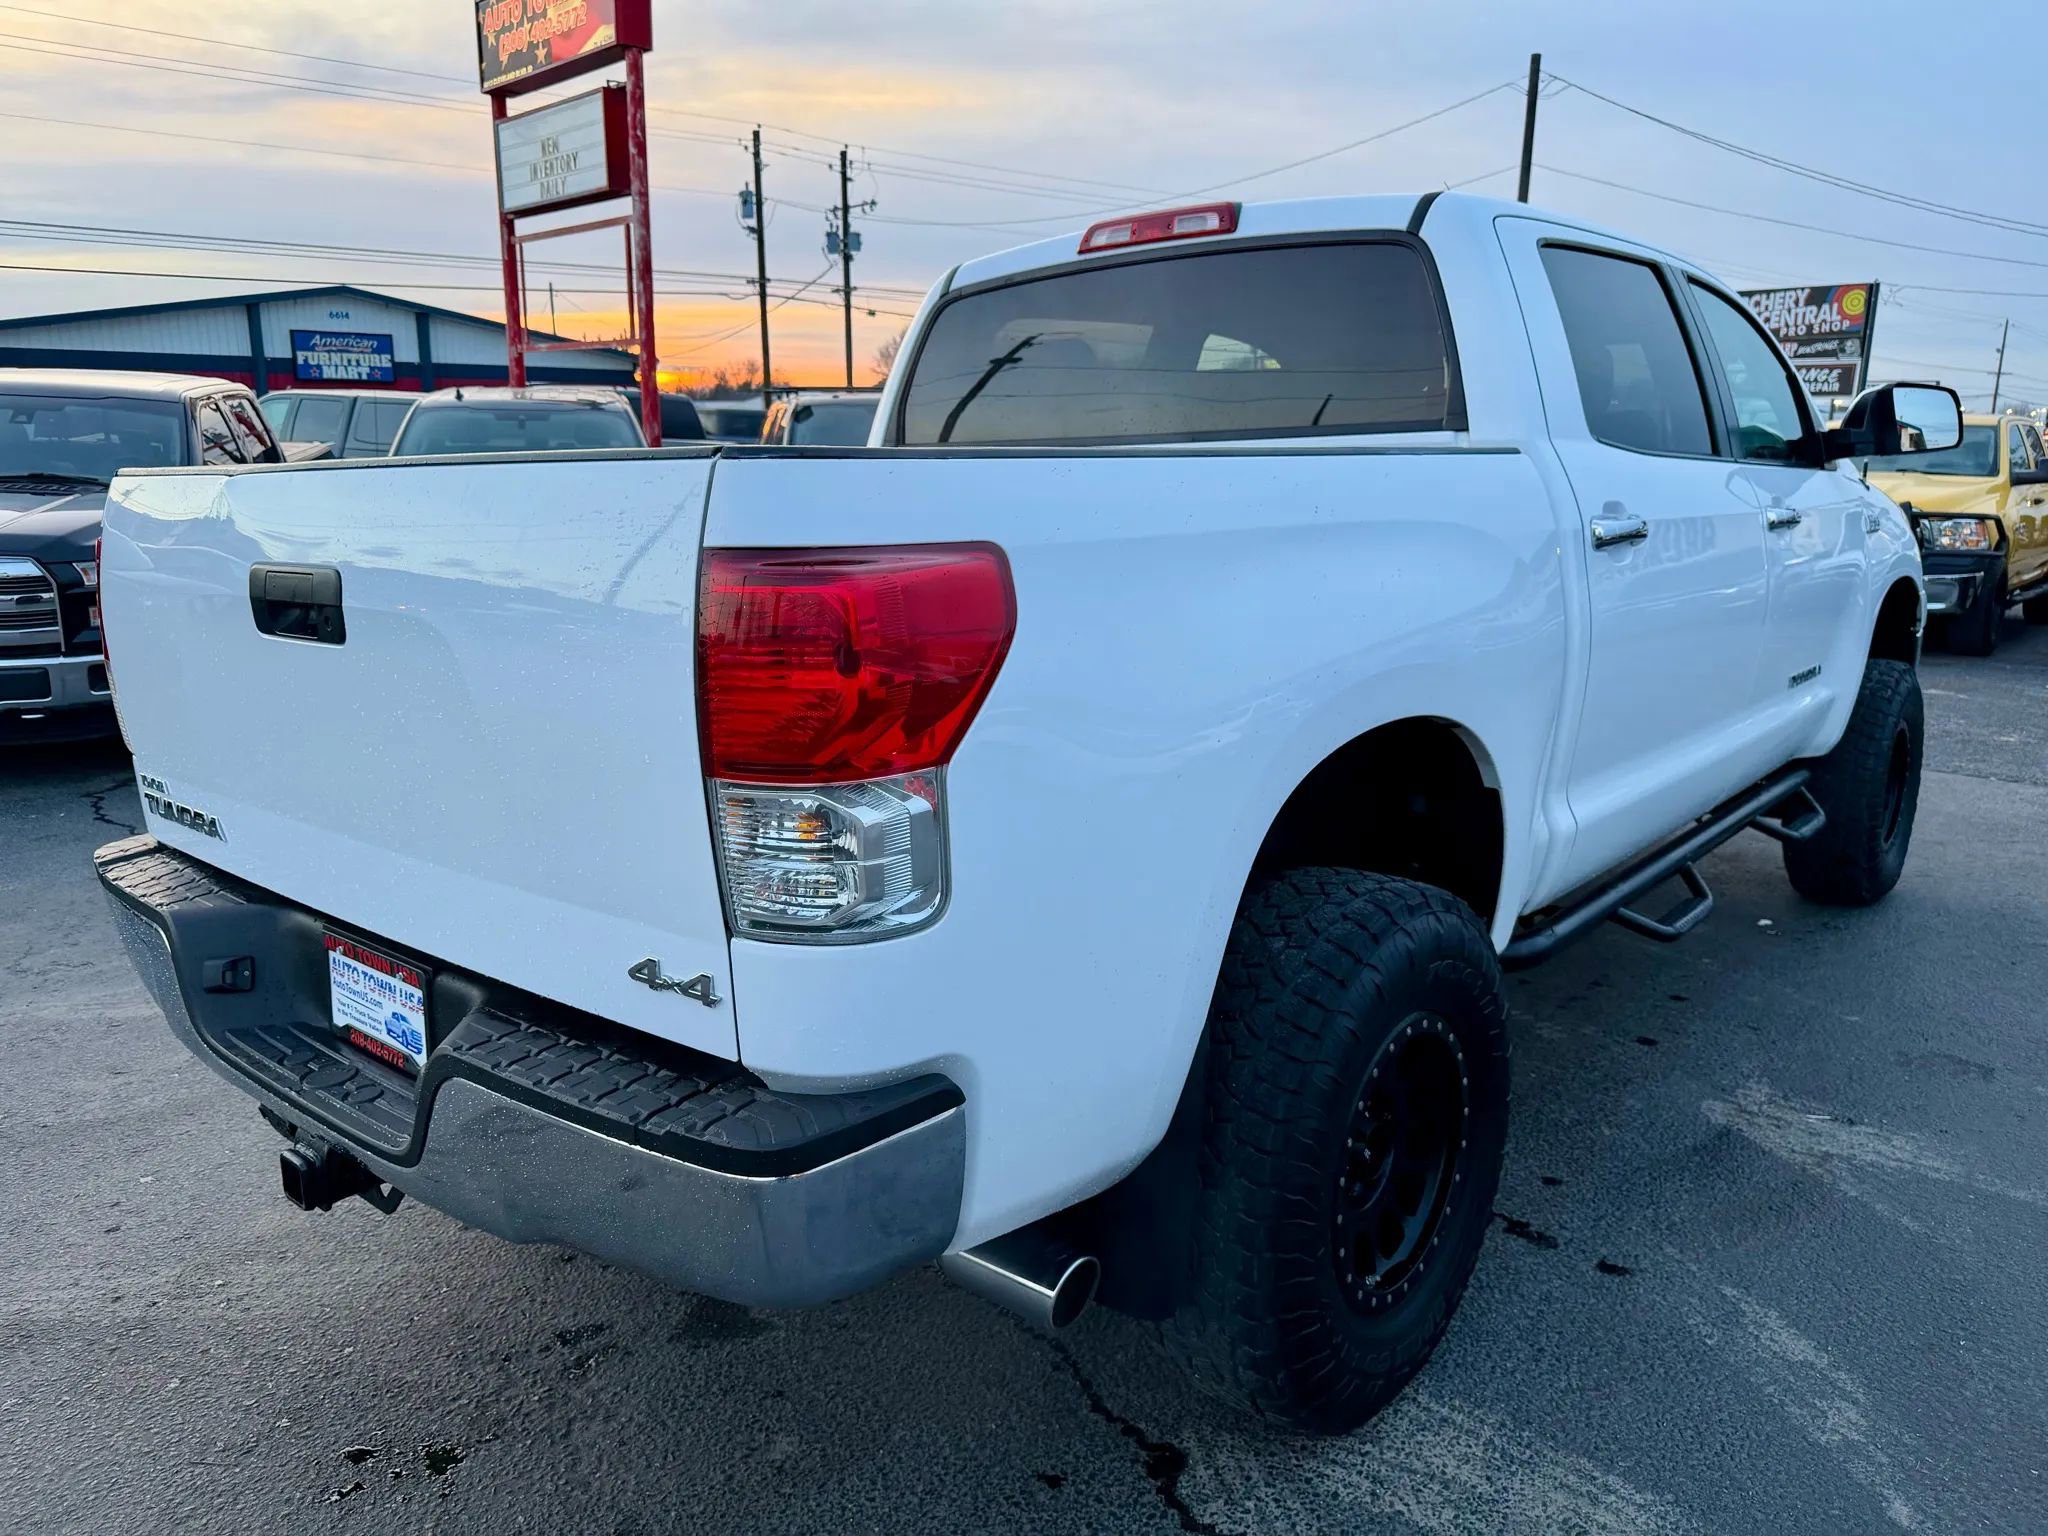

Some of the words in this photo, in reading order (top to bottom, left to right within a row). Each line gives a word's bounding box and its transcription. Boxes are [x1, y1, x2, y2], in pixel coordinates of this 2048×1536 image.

[484, 0, 523, 35] AUTO
[541, 135, 559, 157] NEW
[529, 151, 578, 183] INVENTORY
[540, 175, 567, 200] DAILY
[1746, 288, 1811, 313] CHERY
[329, 311, 350, 320] 6614
[1759, 302, 1842, 329] CENTRAL
[1780, 326, 1807, 337] PRO
[1812, 319, 1850, 335] SHOP
[309, 333, 378, 349] American
[296, 351, 392, 368] FURNITURE
[322, 365, 371, 380] MART
[1798, 367, 1842, 382] ANGE
[144, 790, 228, 843] TUNDRA
[324, 934, 355, 959] AUTO
[358, 947, 391, 974] TOWN
[394, 962, 420, 987] USA
[332, 956, 360, 985] AUTO
[361, 970, 397, 1003] TOWN
[333, 976, 384, 1010] AutoTownUS.com
